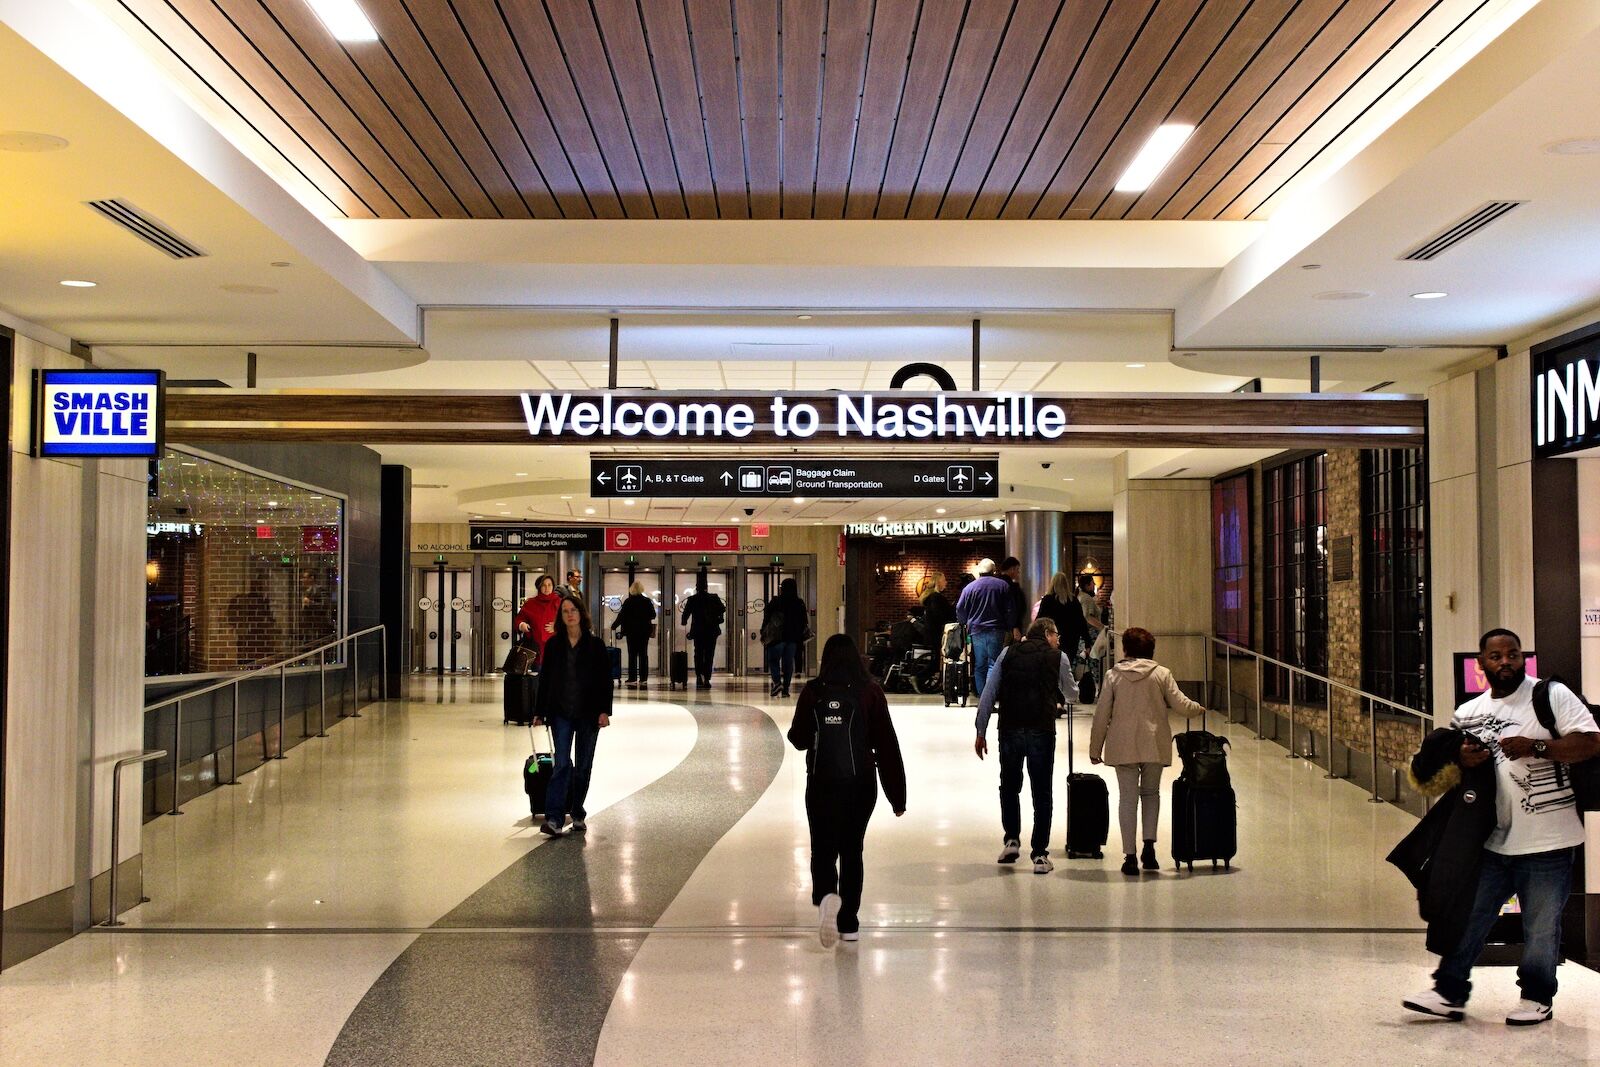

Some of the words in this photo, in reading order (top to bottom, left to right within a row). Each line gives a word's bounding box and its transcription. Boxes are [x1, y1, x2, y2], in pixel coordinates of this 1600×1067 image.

[54, 392, 148, 410] SMASH
[520, 393, 754, 437] Welcome
[770, 397, 819, 438] to
[838, 394, 1066, 438] Nashville
[54, 412, 148, 435] VILLE
[796, 469, 831, 478] Baggage
[833, 469, 855, 477] Claim
[645, 475, 653, 484] A,
[656, 475, 664, 484] B,
[666, 475, 672, 483] &
[680, 475, 704, 483] Gates
[922, 475, 945, 483] Gates
[796, 481, 826, 489] Ground
[828, 481, 883, 489] Transportation
[871, 522, 927, 536] GREEN
[933, 519, 984, 534] ROOM
[548, 532, 587, 540] Transportation
[647, 535, 659, 543] No
[662, 535, 697, 545] Re-Entry
